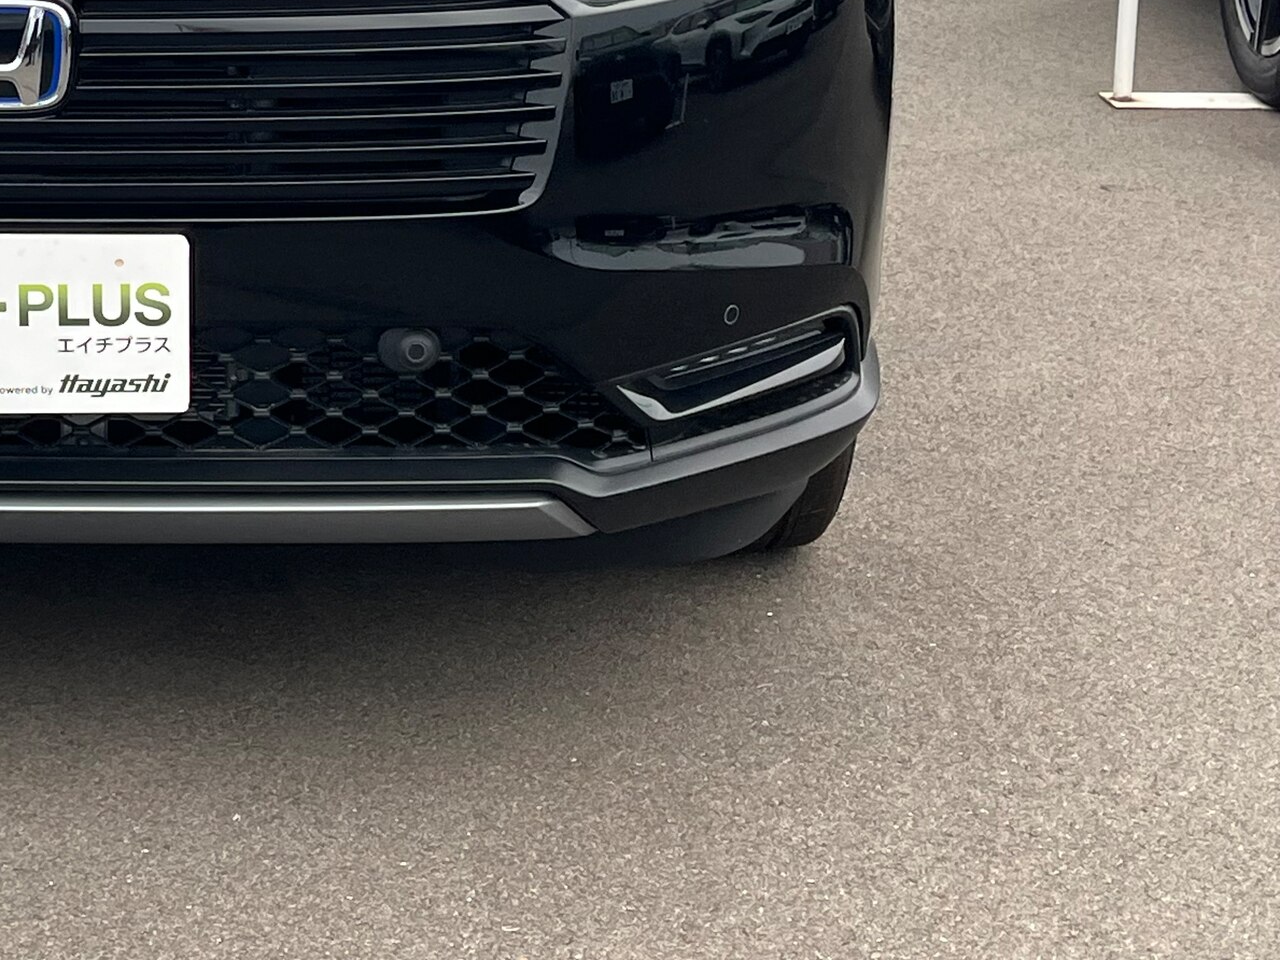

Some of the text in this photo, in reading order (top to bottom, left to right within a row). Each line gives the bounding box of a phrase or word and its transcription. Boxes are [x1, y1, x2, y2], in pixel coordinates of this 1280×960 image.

[57, 336, 172, 354] エイチプラス
[40, 385, 54, 398] by
[58, 372, 172, 398] Hayashi
